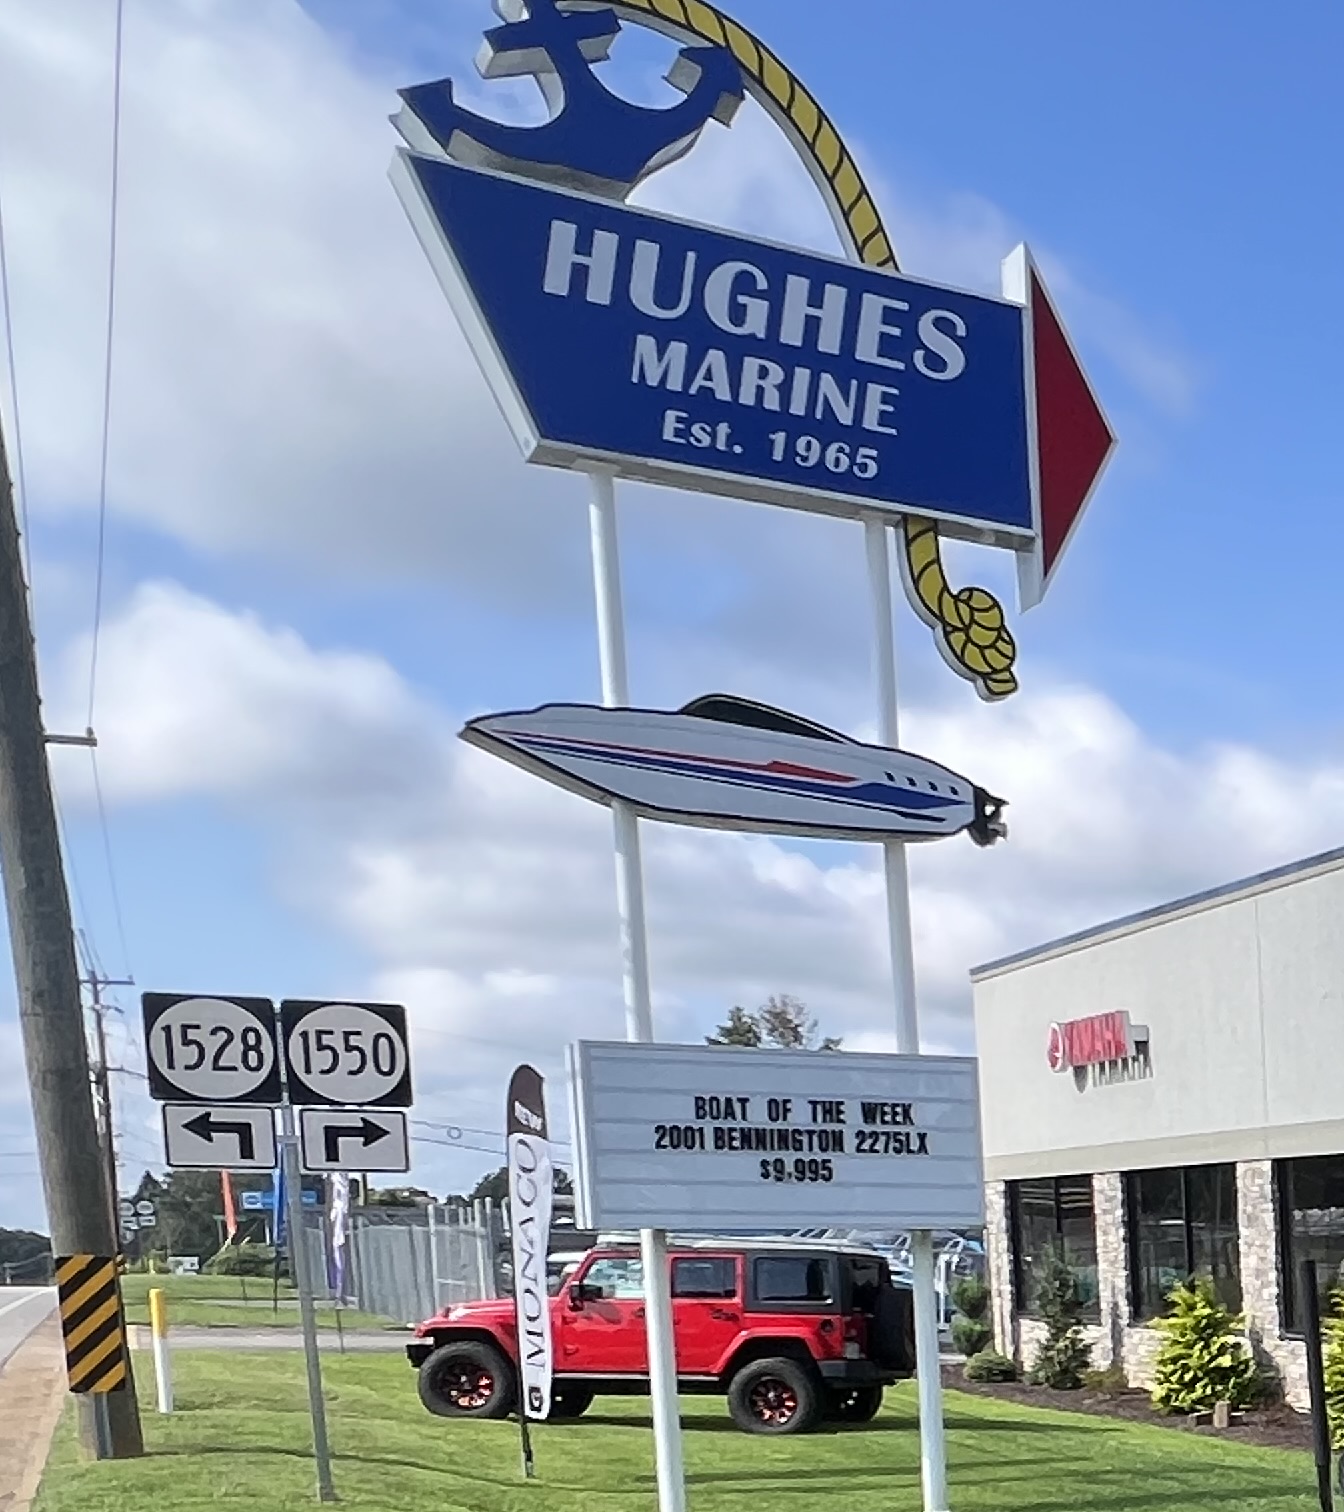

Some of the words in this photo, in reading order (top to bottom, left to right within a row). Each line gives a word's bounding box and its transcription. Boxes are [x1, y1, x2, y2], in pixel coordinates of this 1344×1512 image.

[541, 218, 969, 382] HUGHES
[630, 334, 900, 436] MARINE
[661, 410, 744, 456] Est.
[767, 430, 880, 480] 1965
[160, 1024, 264, 1072] 1528
[298, 1029, 397, 1077] 1550
[654, 1125, 705, 1150] 2001
[713, 1126, 844, 1153] BENNINGTON
[855, 1130, 930, 1155] 2275LX
[695, 1096, 750, 1122] BOAT
[766, 1098, 793, 1123] OF
[808, 1100, 846, 1124] THE
[861, 1102, 914, 1126] WEEK
[515, 1138, 546, 1372] MONACO
